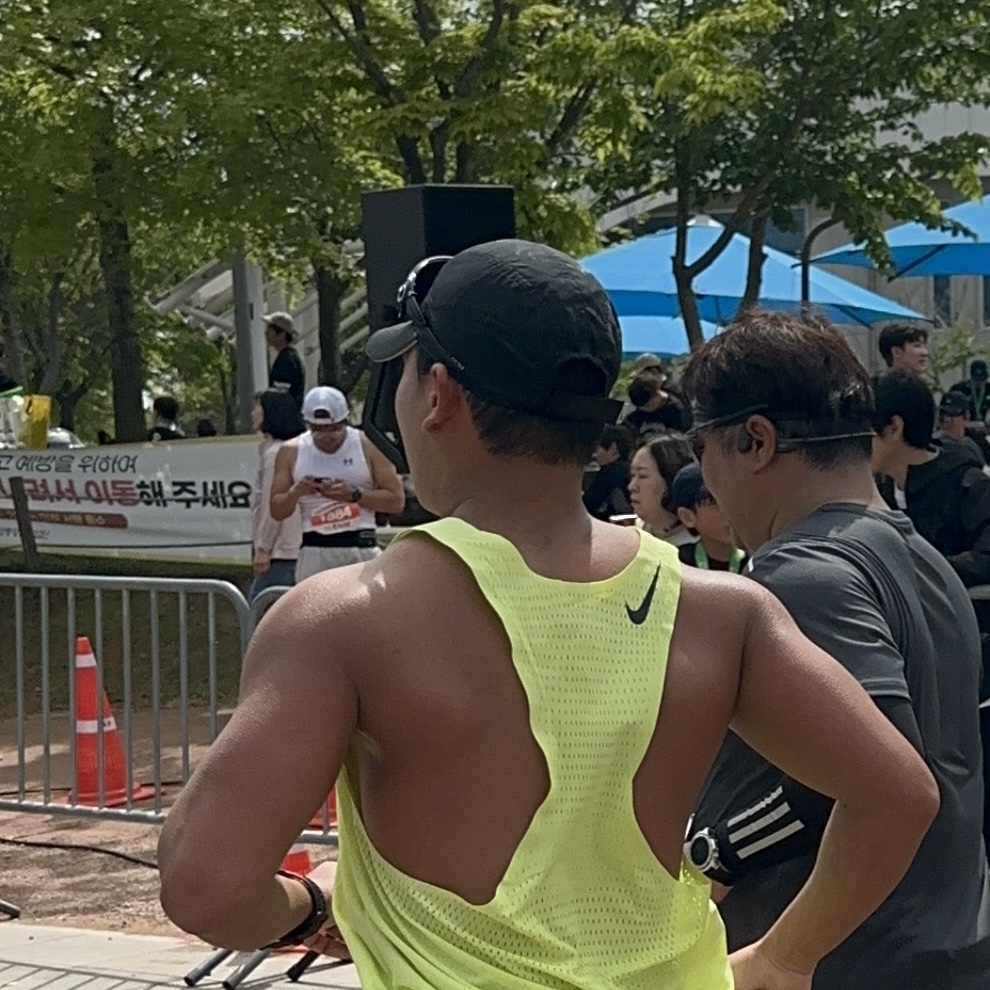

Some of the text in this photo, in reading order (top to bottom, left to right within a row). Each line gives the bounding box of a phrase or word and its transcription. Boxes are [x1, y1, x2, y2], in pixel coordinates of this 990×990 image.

[16, 455, 75, 473] 예방을
[79, 455, 138, 473] 위하여
[85, 480, 168, 507] 이동해
[172, 480, 252, 509] 주세요
